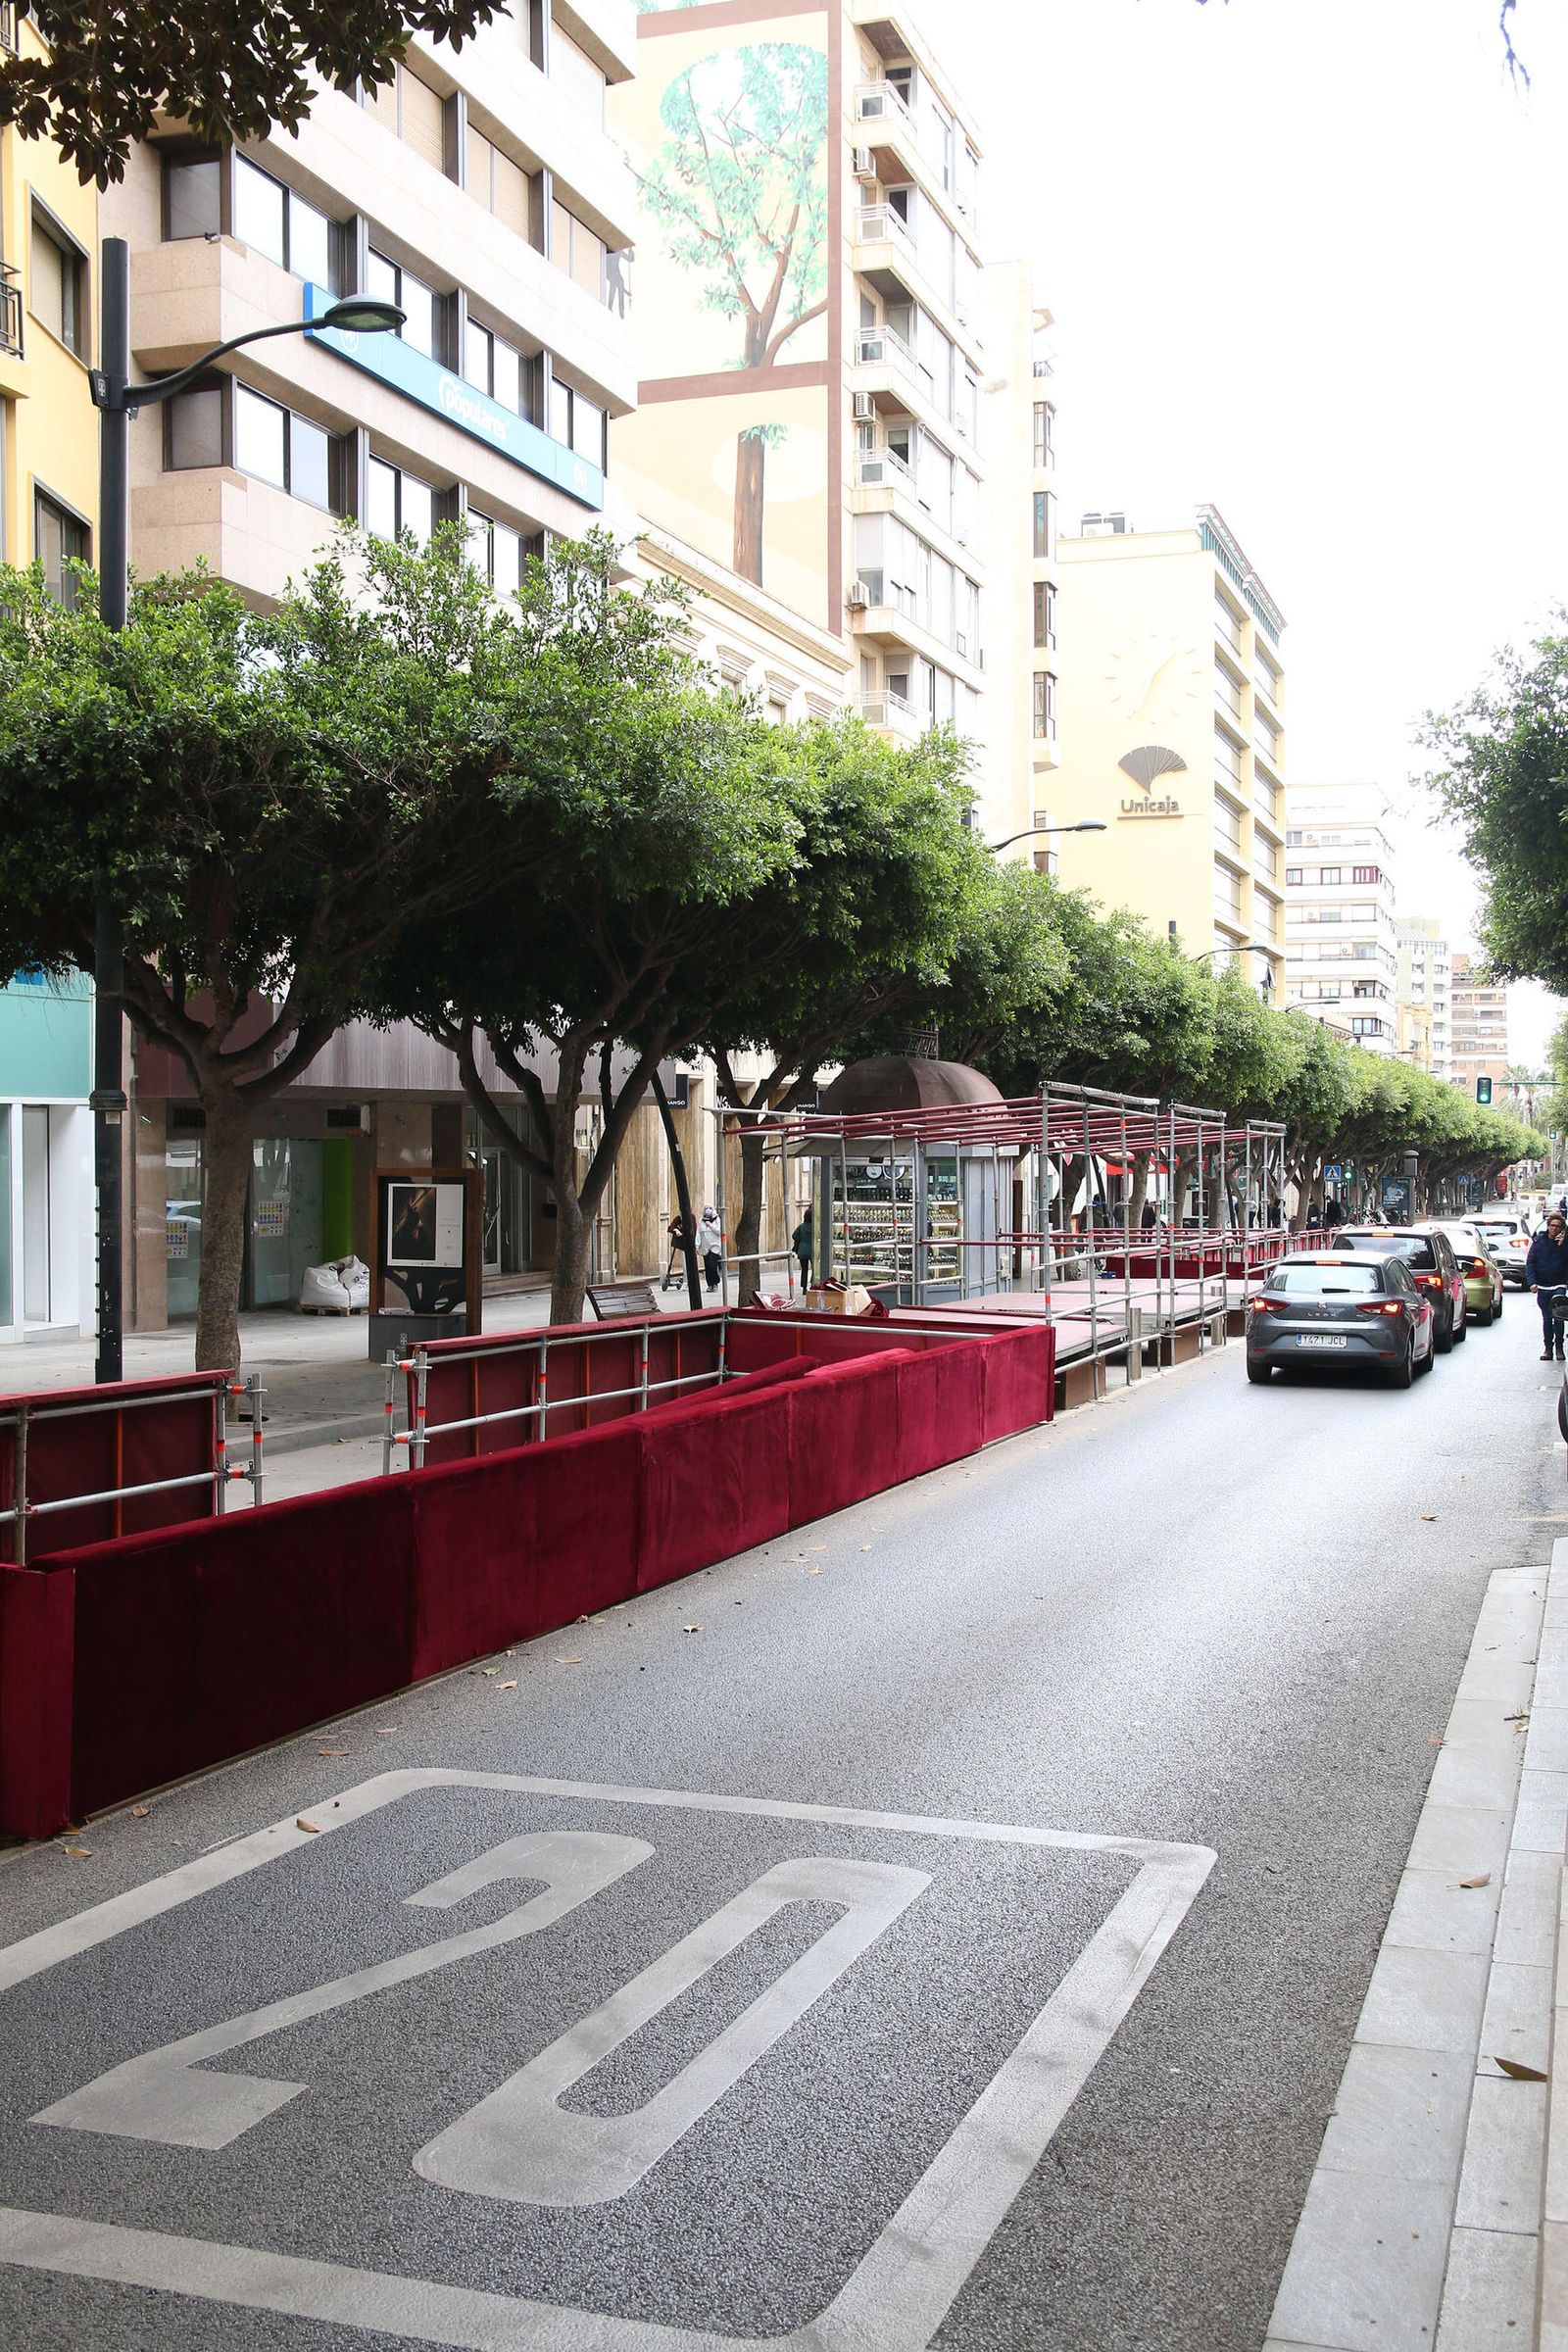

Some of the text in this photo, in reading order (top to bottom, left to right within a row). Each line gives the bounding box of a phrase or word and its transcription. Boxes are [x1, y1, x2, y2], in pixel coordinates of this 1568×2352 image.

[446, 389, 507, 440] populares
[1121, 796, 1179, 814] Unicaja
[1328, 1335, 1345, 1345] JCL
[27, 1831, 933, 2207] 20
